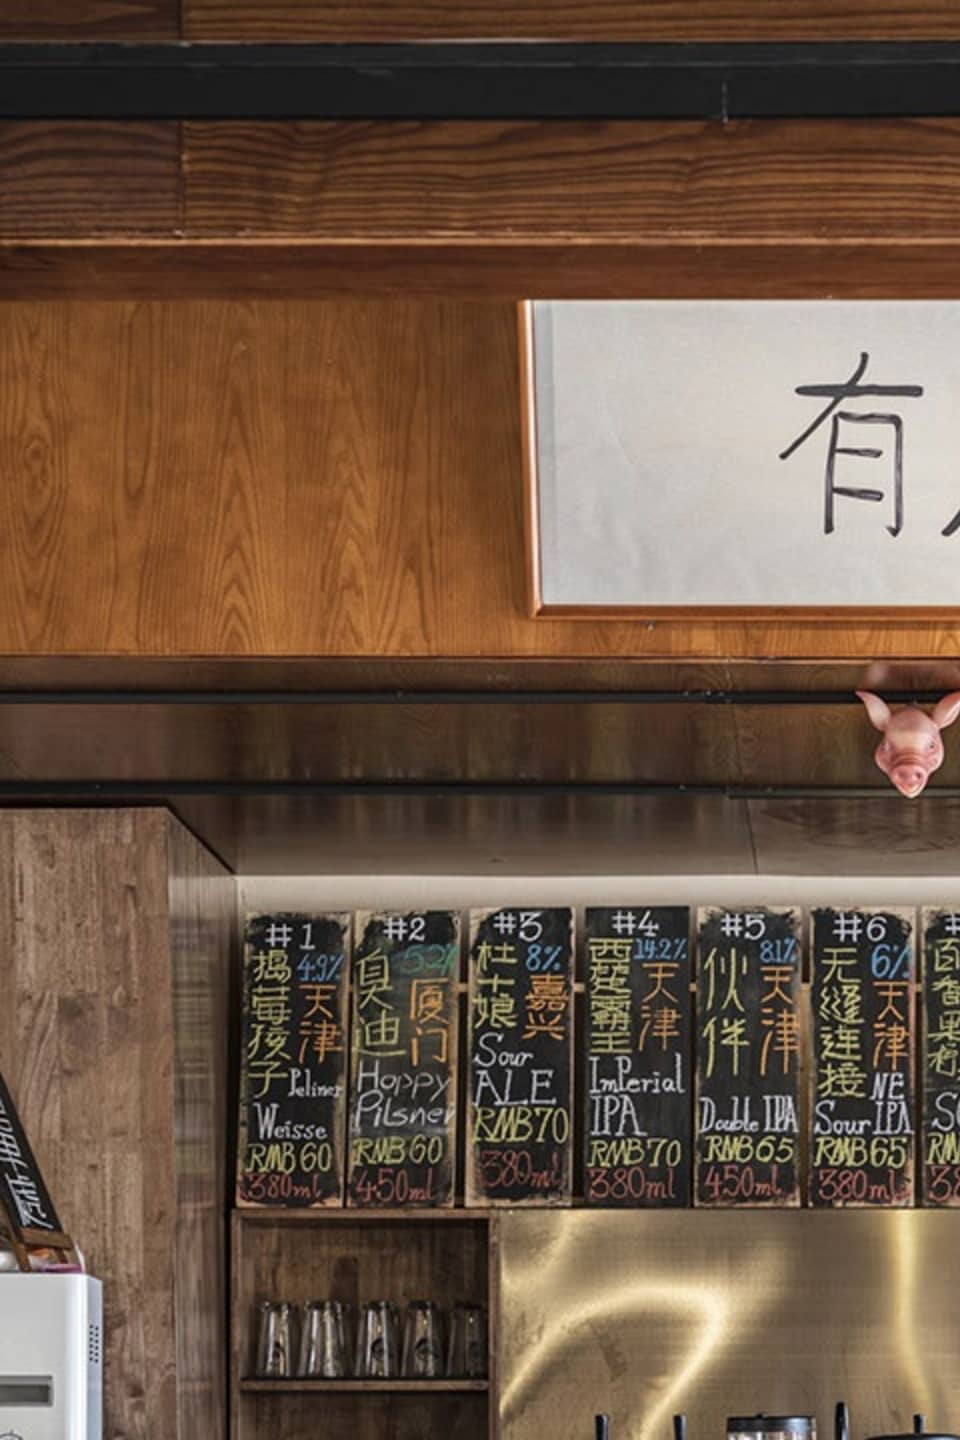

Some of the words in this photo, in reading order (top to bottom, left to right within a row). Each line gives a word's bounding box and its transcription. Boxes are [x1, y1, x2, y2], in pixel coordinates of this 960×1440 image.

[384, 917, 425, 942] #2
[494, 911, 542, 942] #3
[612, 911, 659, 938] #4
[721, 913, 765, 940] #5
[832, 911, 888, 942] #6
[525, 944, 561, 971] 8%
[472, 941, 517, 1029] 杜十娘
[299, 984, 345, 1066] 天津
[639, 962, 682, 1051] 天津
[703, 948, 750, 1077] 伙伴
[760, 965, 801, 1076] 天津
[873, 981, 910, 1072] 天津
[474, 1032, 533, 1068] Sour
[473, 1069, 557, 1106] ALE
[870, 1072, 904, 1100] NE
[253, 1103, 329, 1140] Weisse
[590, 1095, 648, 1136] IPA
